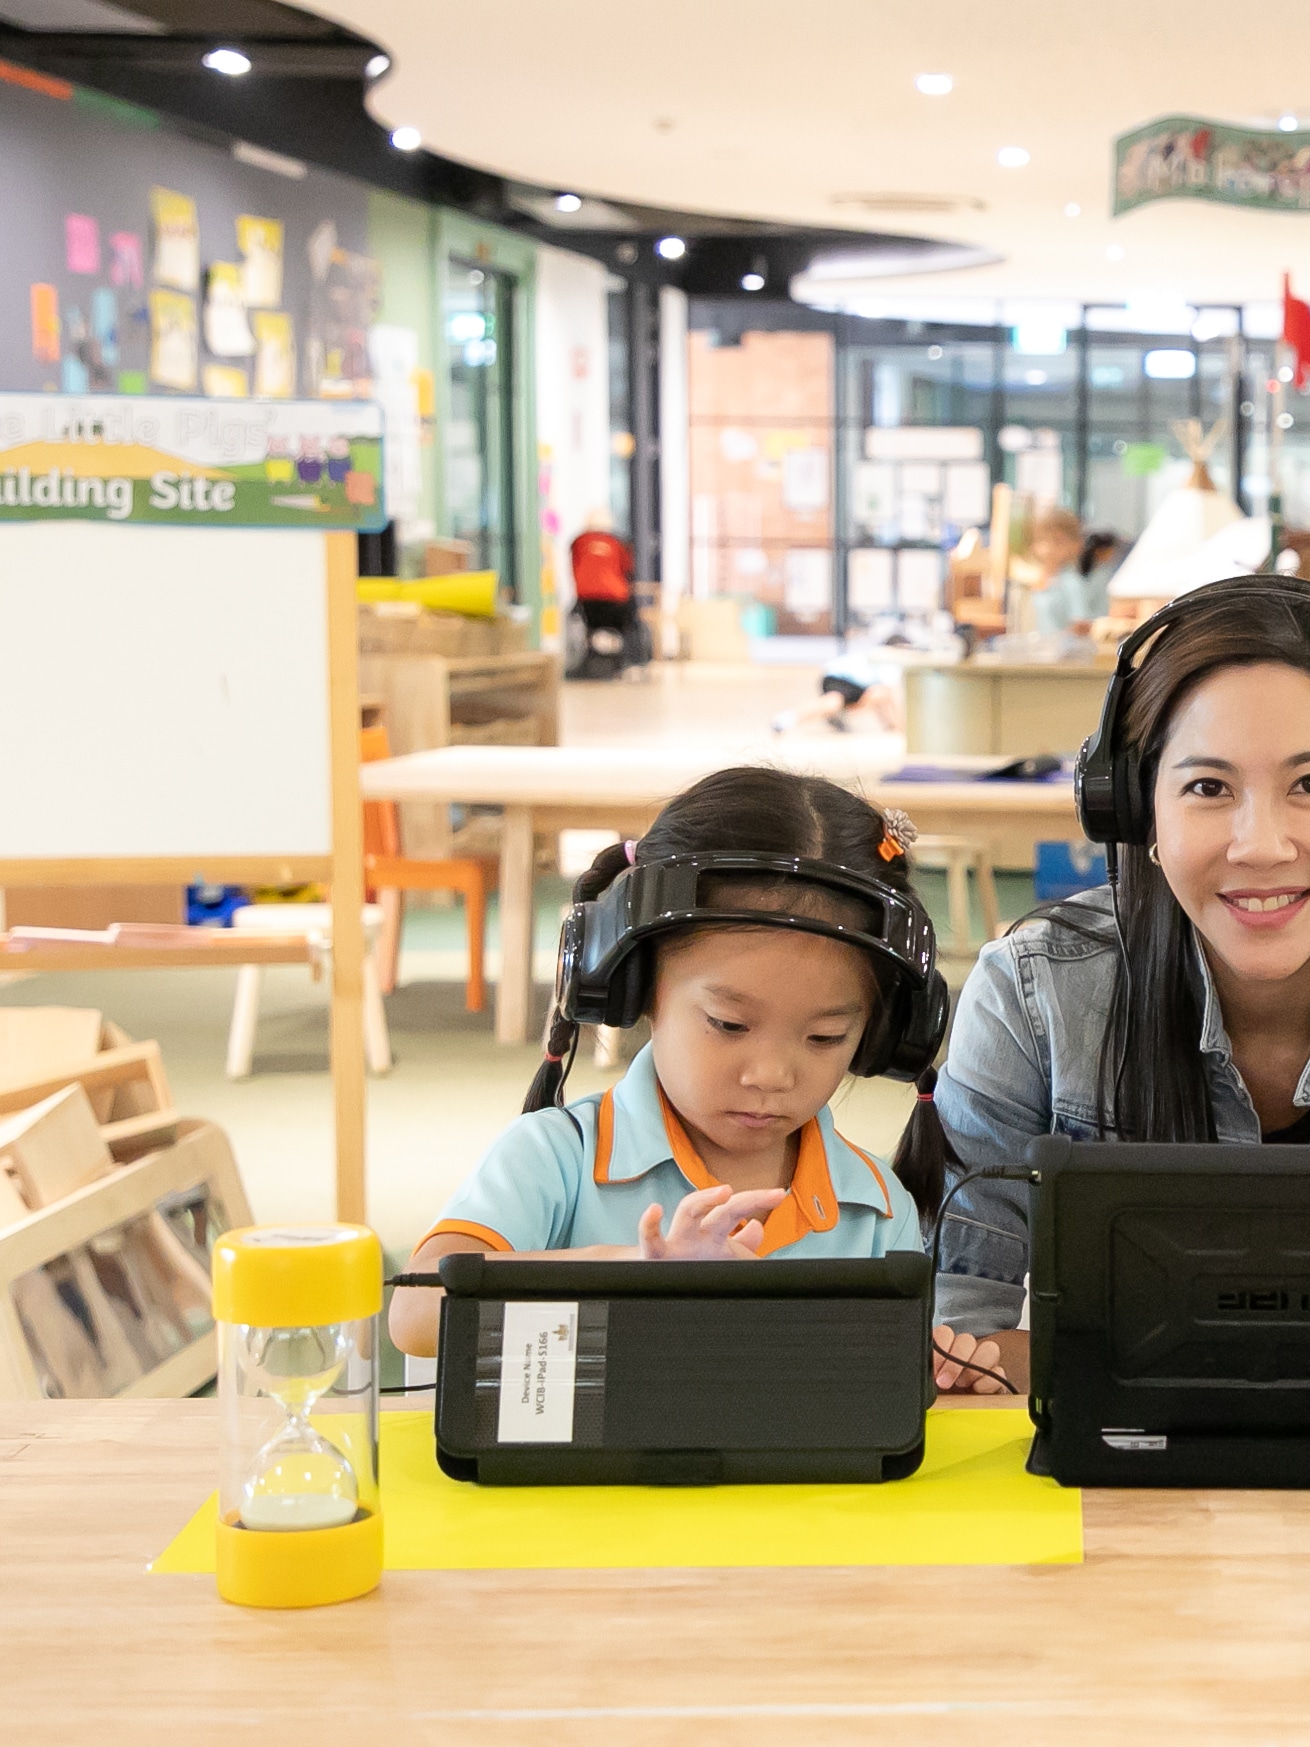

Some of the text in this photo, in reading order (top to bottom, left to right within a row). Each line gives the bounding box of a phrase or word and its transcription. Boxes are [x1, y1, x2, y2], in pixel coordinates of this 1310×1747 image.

[42, 404, 160, 446] Little
[0, 468, 236, 519] ilding Site
[521, 1372, 532, 1404] Device
